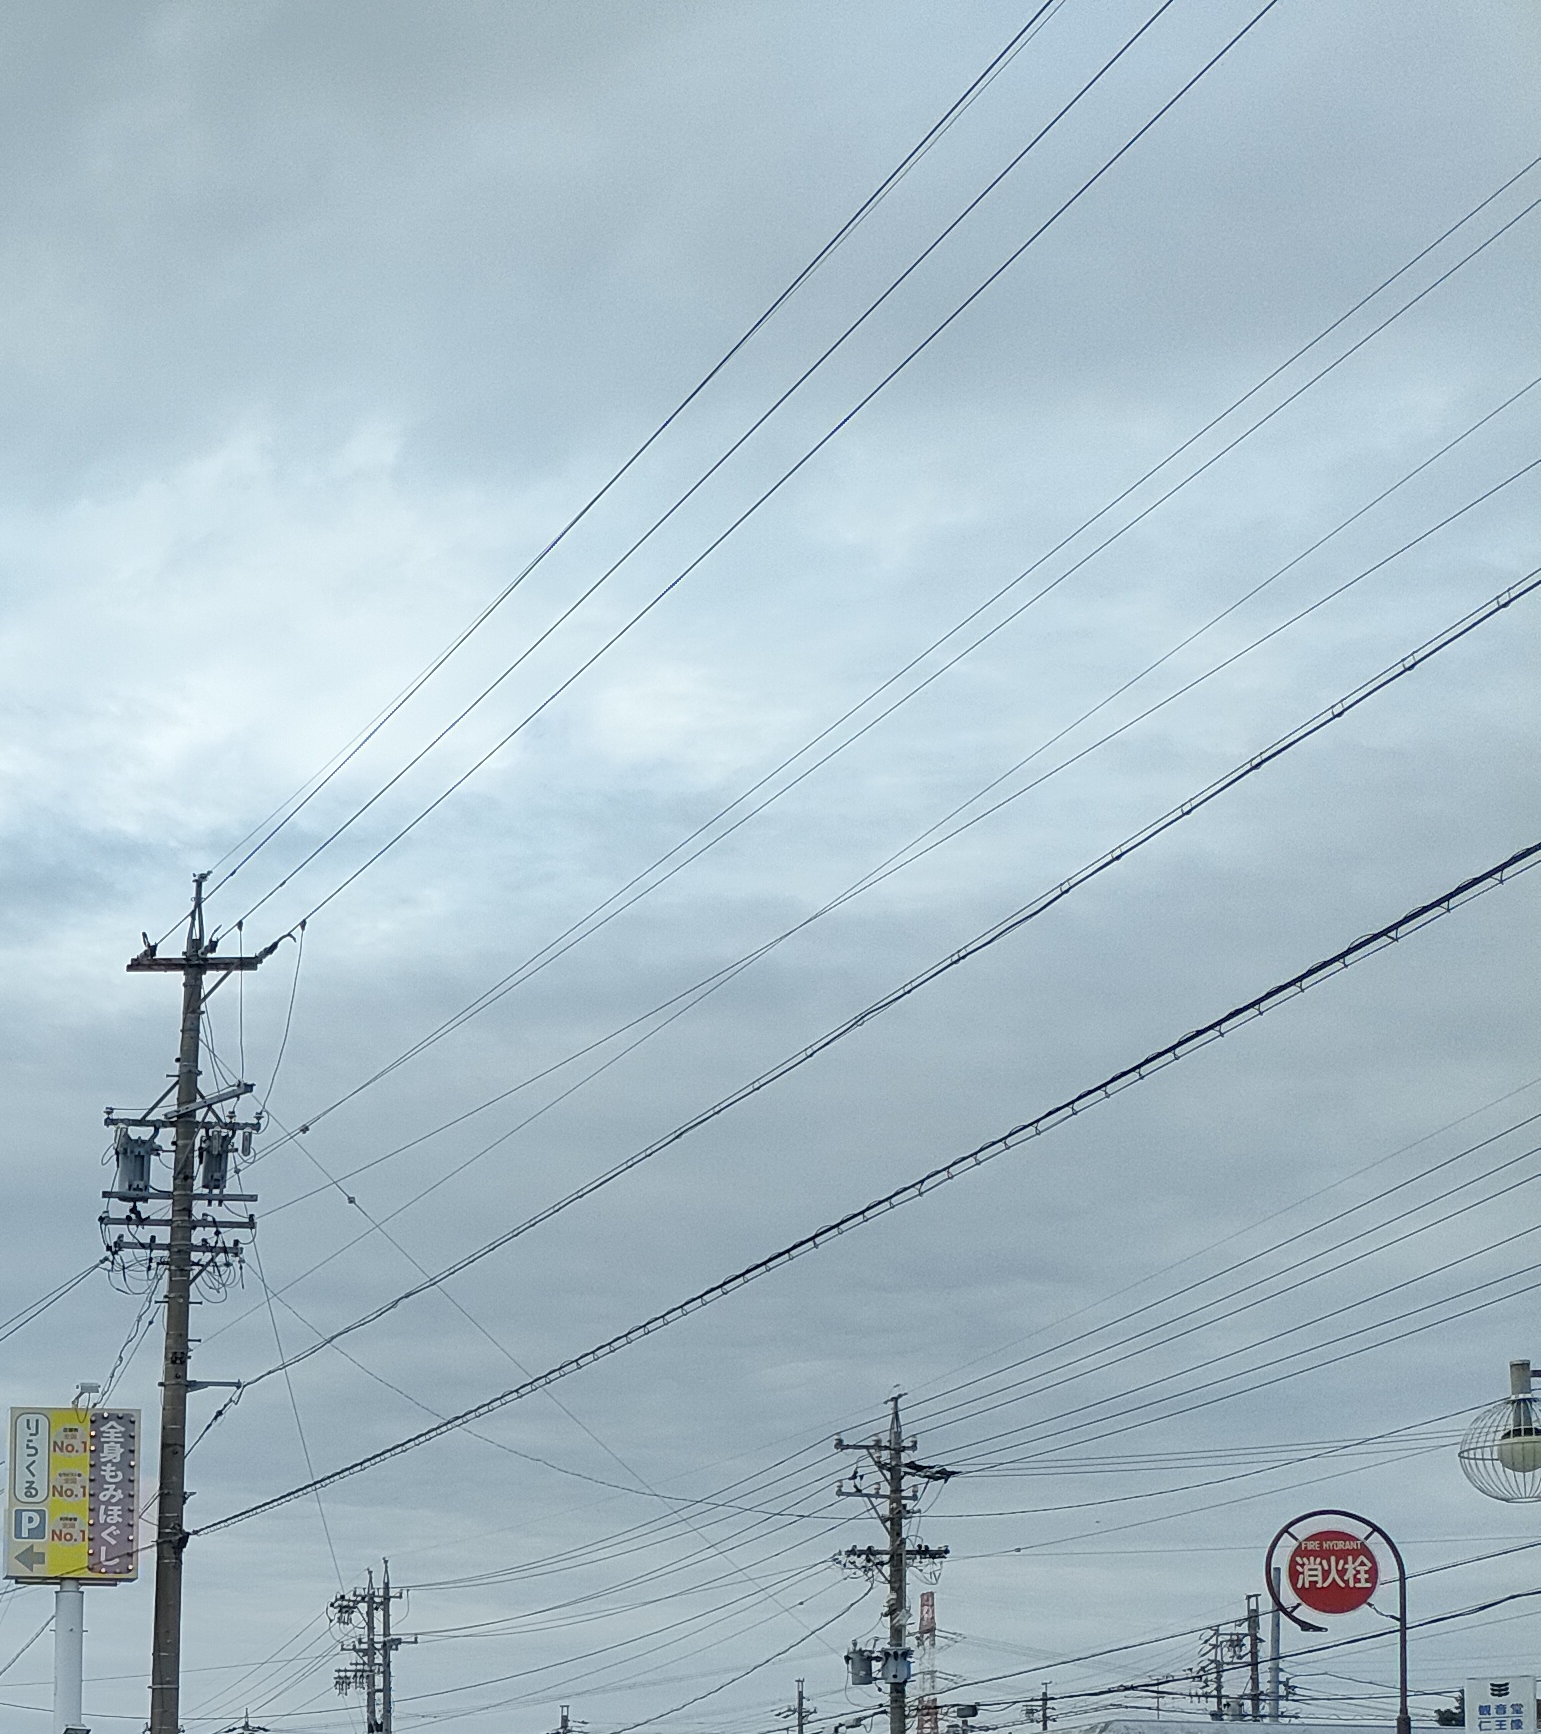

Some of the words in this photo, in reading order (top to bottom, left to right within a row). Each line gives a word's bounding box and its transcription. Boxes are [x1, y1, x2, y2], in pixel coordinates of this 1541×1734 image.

[52, 1441, 88, 1453] No.1
[24, 1419, 39, 1498] りらくる
[51, 1485, 87, 1498] No.1
[99, 1421, 125, 1565] 全身もみほぐし
[21, 1512, 40, 1538] P
[51, 1529, 86, 1542] No.1
[1301, 1540, 1321, 1551] FIRE
[1323, 1540, 1362, 1551] HYDRANT
[1295, 1555, 1373, 1589] 消火栓
